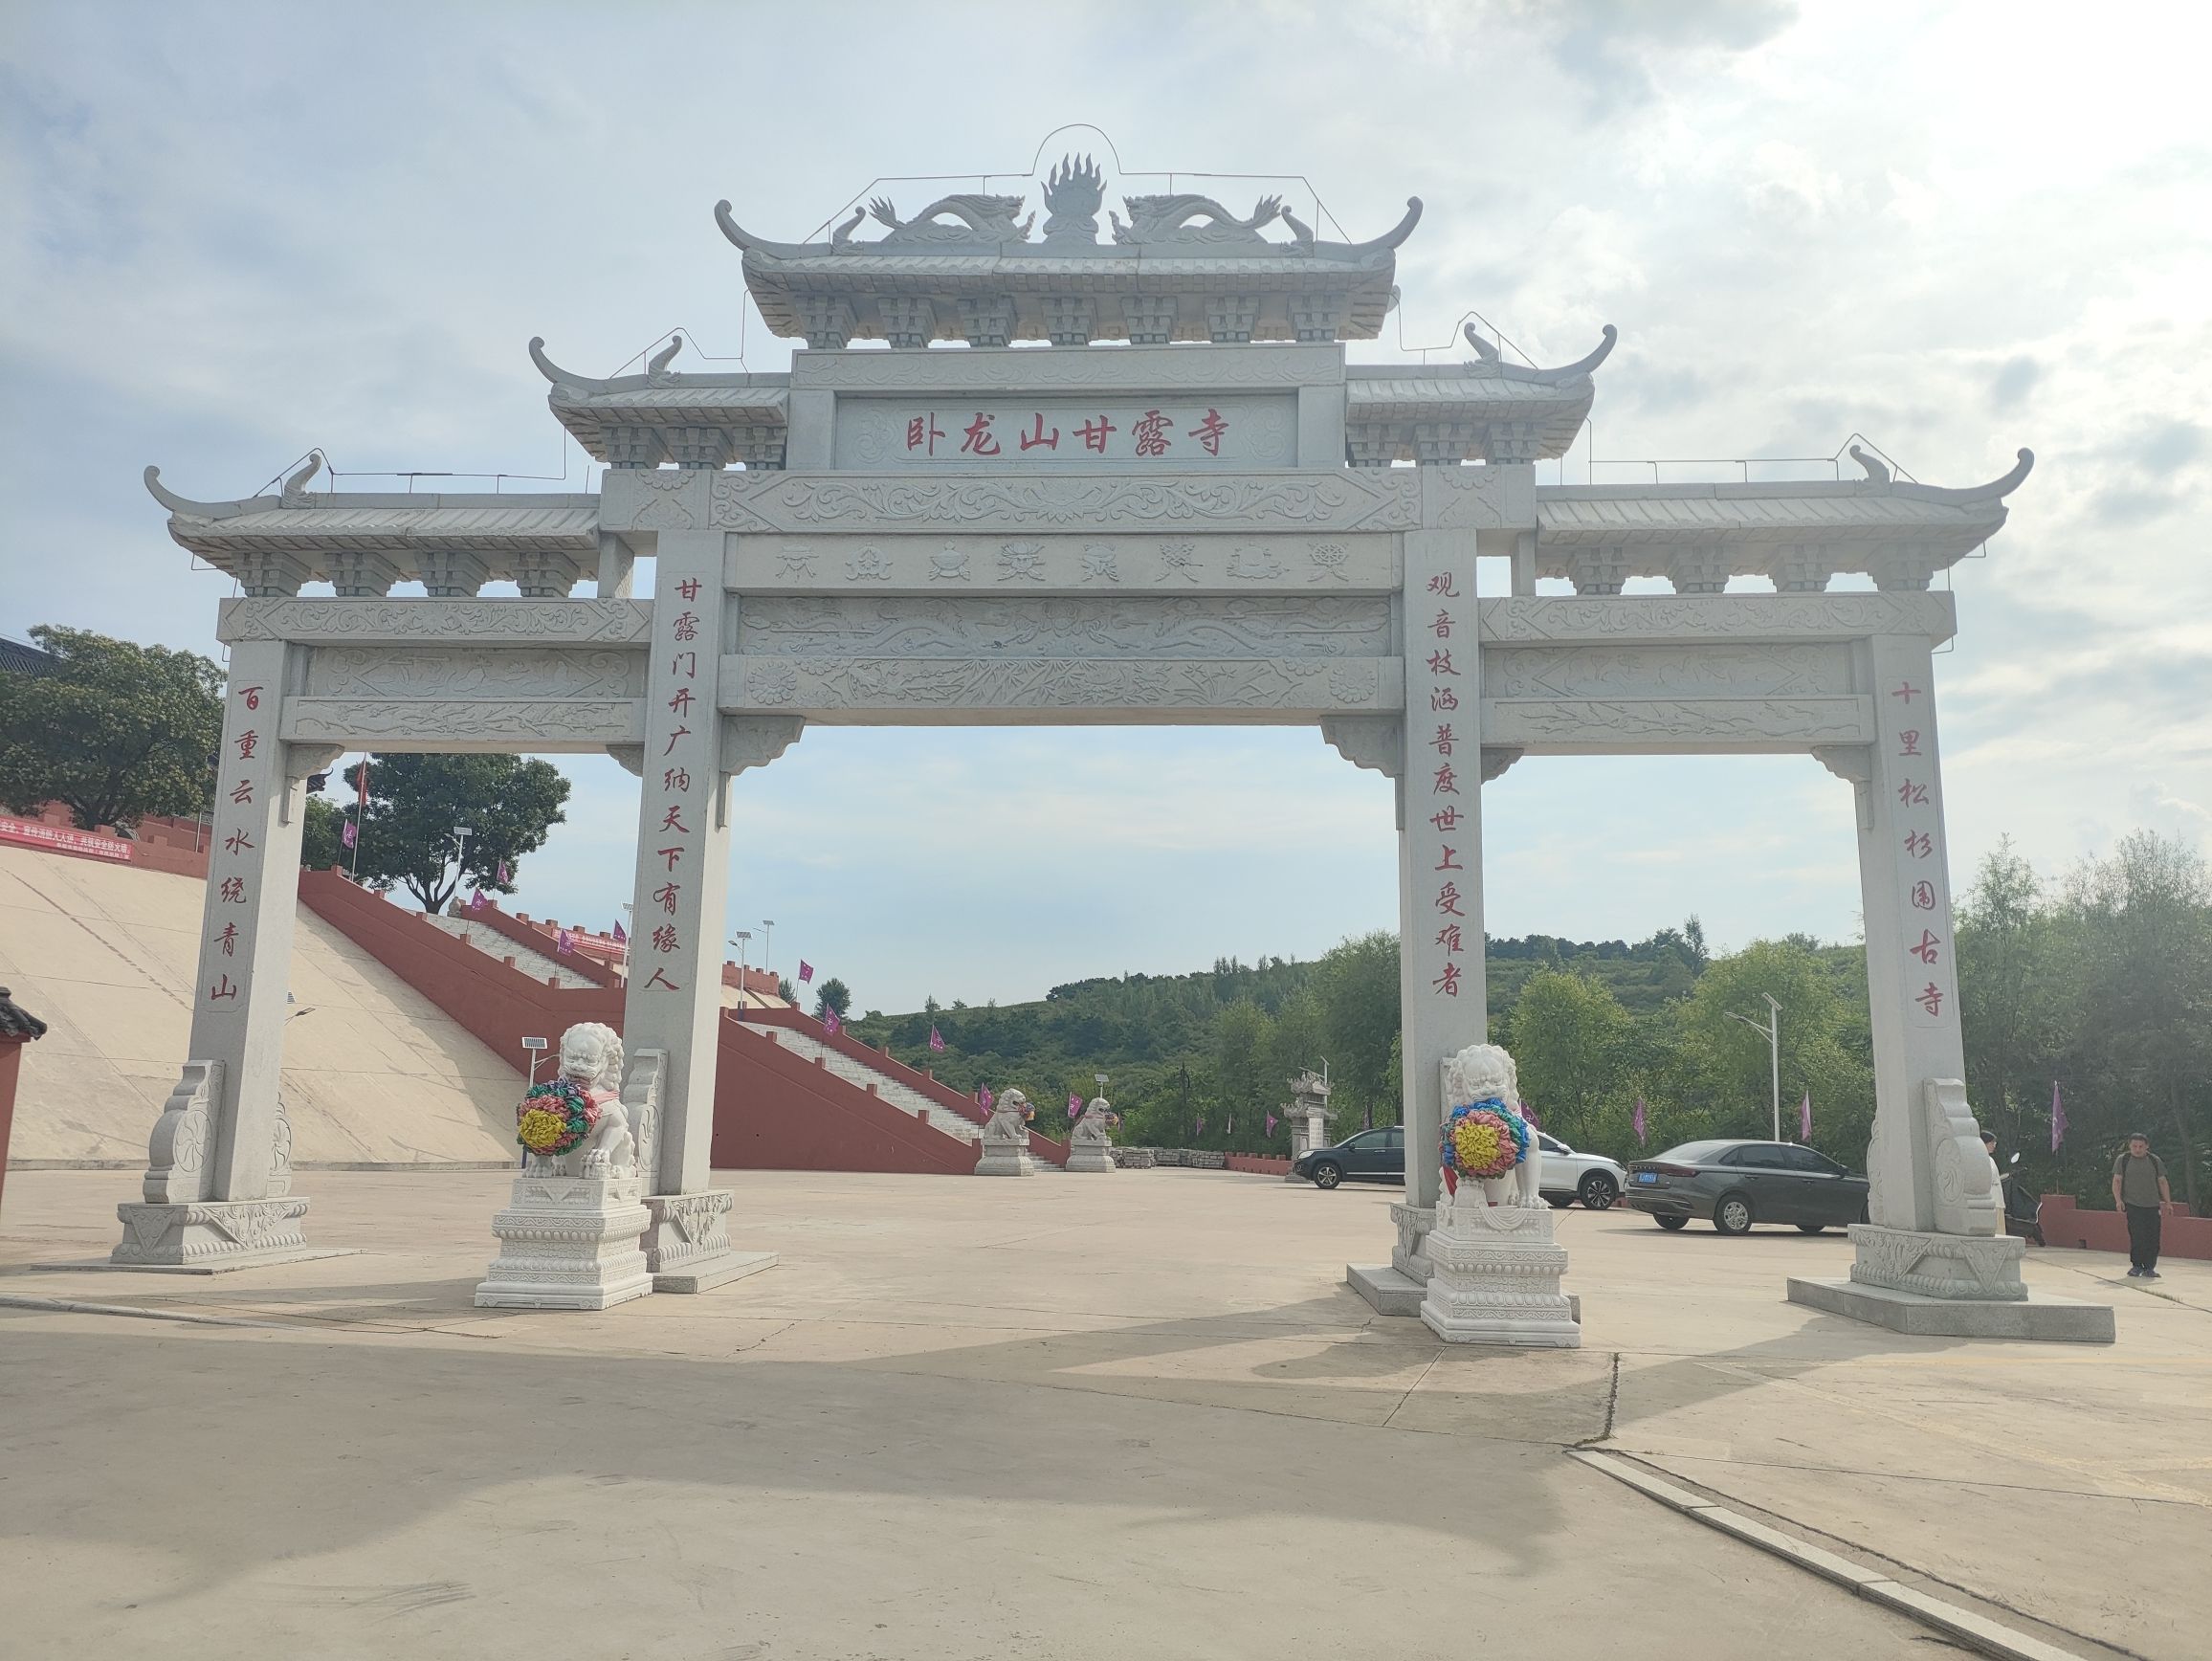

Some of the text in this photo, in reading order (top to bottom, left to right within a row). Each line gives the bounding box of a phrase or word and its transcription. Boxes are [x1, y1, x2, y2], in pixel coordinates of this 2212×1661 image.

[905, 409, 1229, 456] 卧龙山甘露寺
[211, 686, 264, 1001] 百重云水绕青山
[643, 577, 703, 991] 甘露门开广纳天下有缘人
[1426, 571, 1466, 998] 观音枝洒普度世上受难者
[1891, 681, 1945, 1017] 十里松杉围古寺
